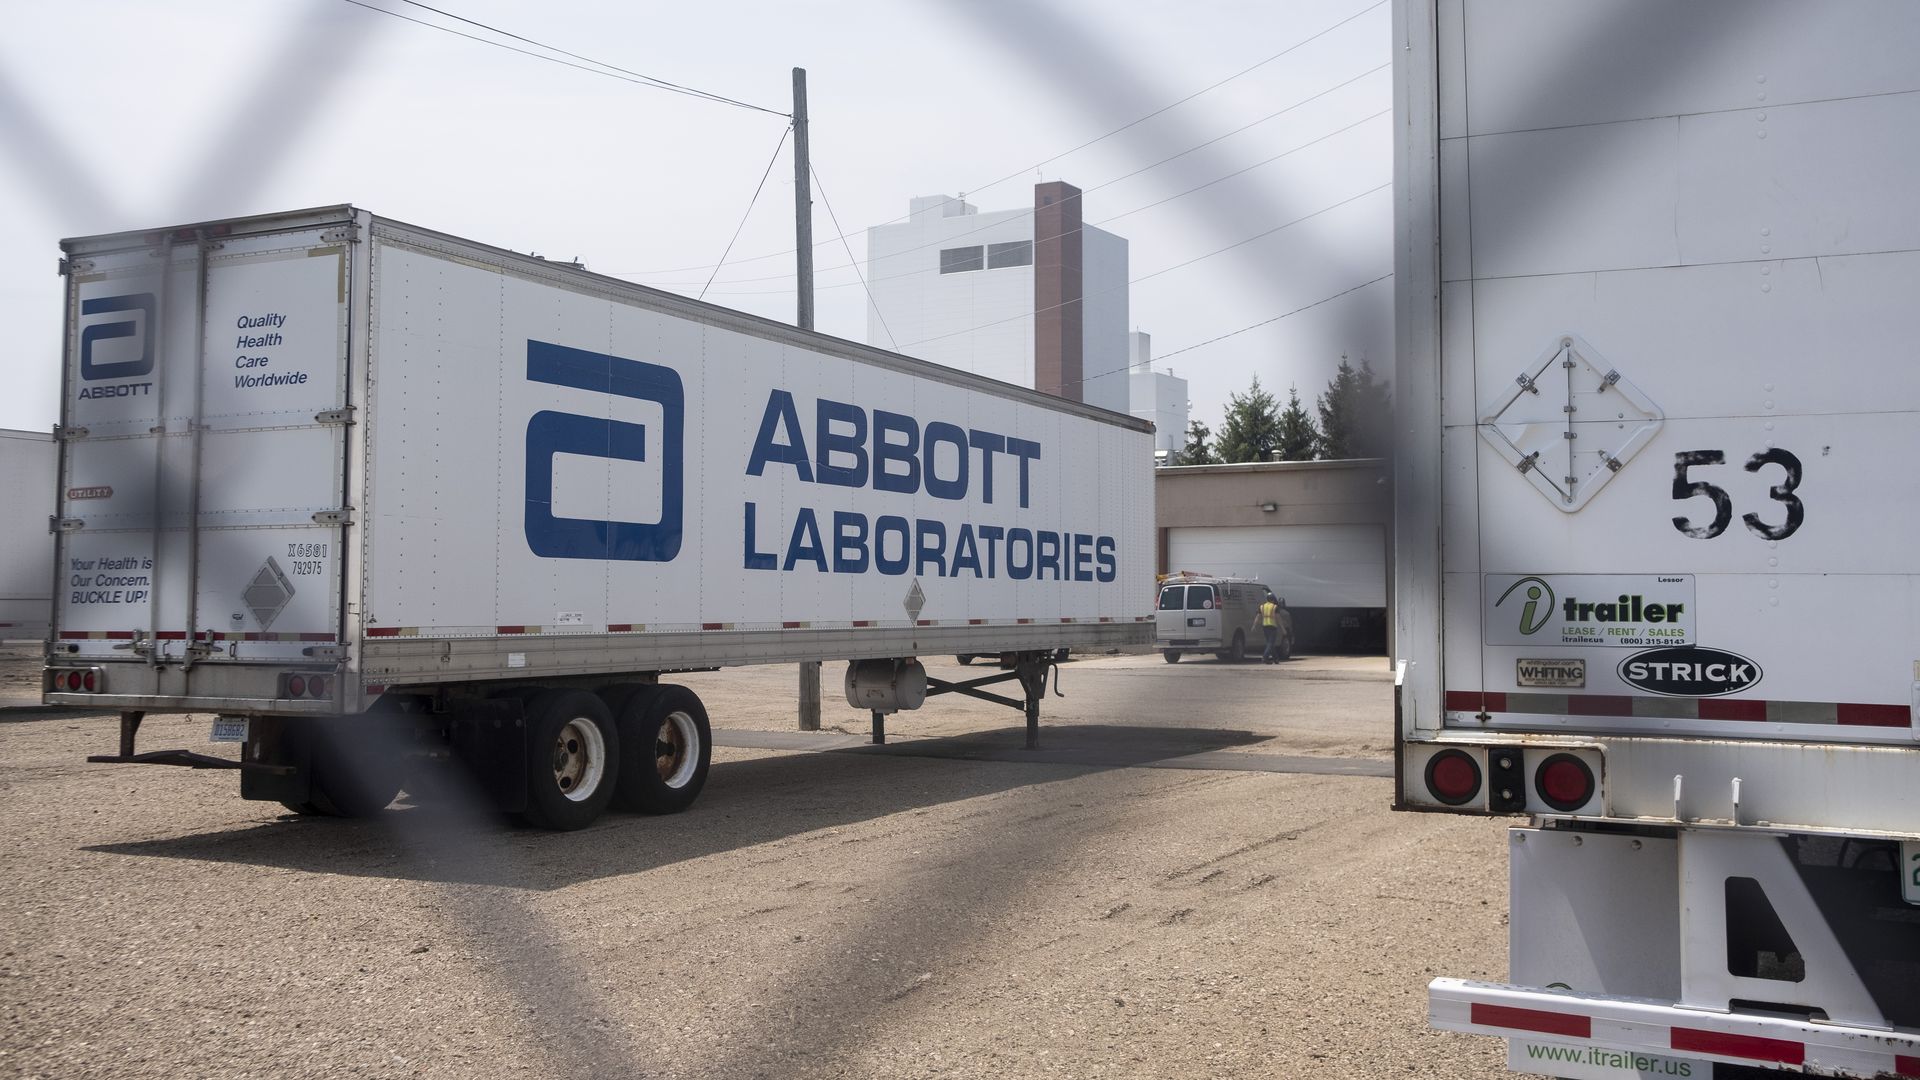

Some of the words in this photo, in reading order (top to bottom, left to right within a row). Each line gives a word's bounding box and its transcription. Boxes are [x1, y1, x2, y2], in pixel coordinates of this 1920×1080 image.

[236, 313, 287, 329] Quality
[236, 333, 283, 349] Health
[235, 355, 269, 369] Care
[234, 371, 308, 388] Worldwide
[78, 382, 153, 400] ABBOTT
[745, 388, 1041, 509] ABBOTT
[70, 487, 109, 498] UTILITY
[1672, 448, 1804, 541] 53
[743, 501, 1117, 583] LABORATORIES
[288, 543, 328, 558] X6581
[71, 558, 96, 571] Your
[97, 557, 138, 570] Health
[141, 556, 153, 570] is
[292, 561, 322, 575] 792975
[70, 574, 92, 587] Our
[95, 574, 150, 587] Concern.
[71, 591, 122, 604] BUCKLE
[125, 590, 149, 604] UP!
[1563, 594, 1684, 623] trailer
[1562, 627, 1596, 636] LEASE
[1607, 627, 1637, 636] RENT
[1648, 628, 1685, 637] SALES
[1620, 637, 1643, 645] (800)
[1519, 666, 1583, 679] WHITING
[1628, 661, 1750, 683] STRICK
[1527, 1044, 1692, 1077] www.itrailer.us
